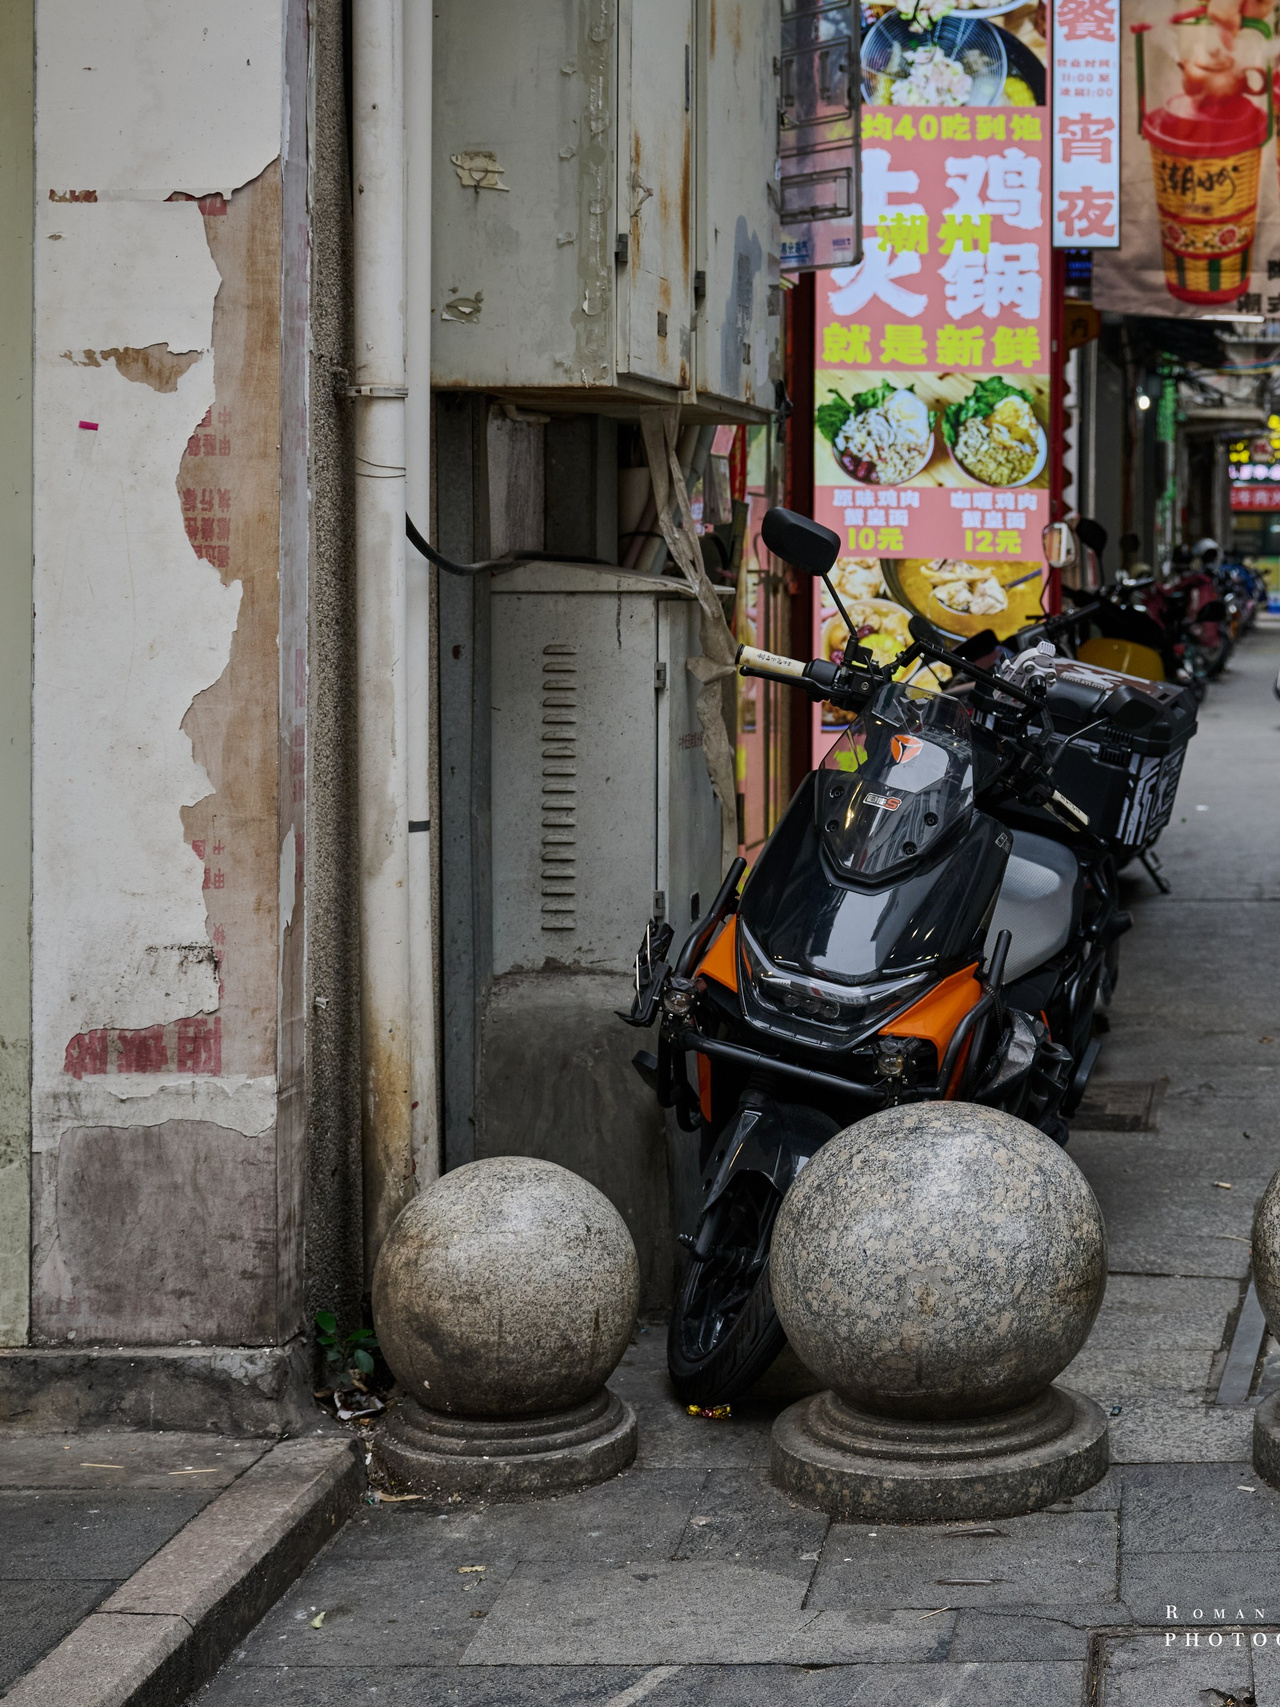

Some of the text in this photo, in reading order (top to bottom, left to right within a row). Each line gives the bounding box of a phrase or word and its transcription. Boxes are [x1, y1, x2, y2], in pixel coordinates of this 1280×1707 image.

[860, 113, 1042, 141] 均40吃到饱
[877, 212, 992, 254] 潮州
[822, 322, 1042, 368] 就是新鲜
[833, 489, 920, 508] 原味鸡肉
[950, 491, 1038, 510] 咖喱鸡肉
[848, 527, 904, 551] 10元
[965, 529, 1022, 553] 12元
